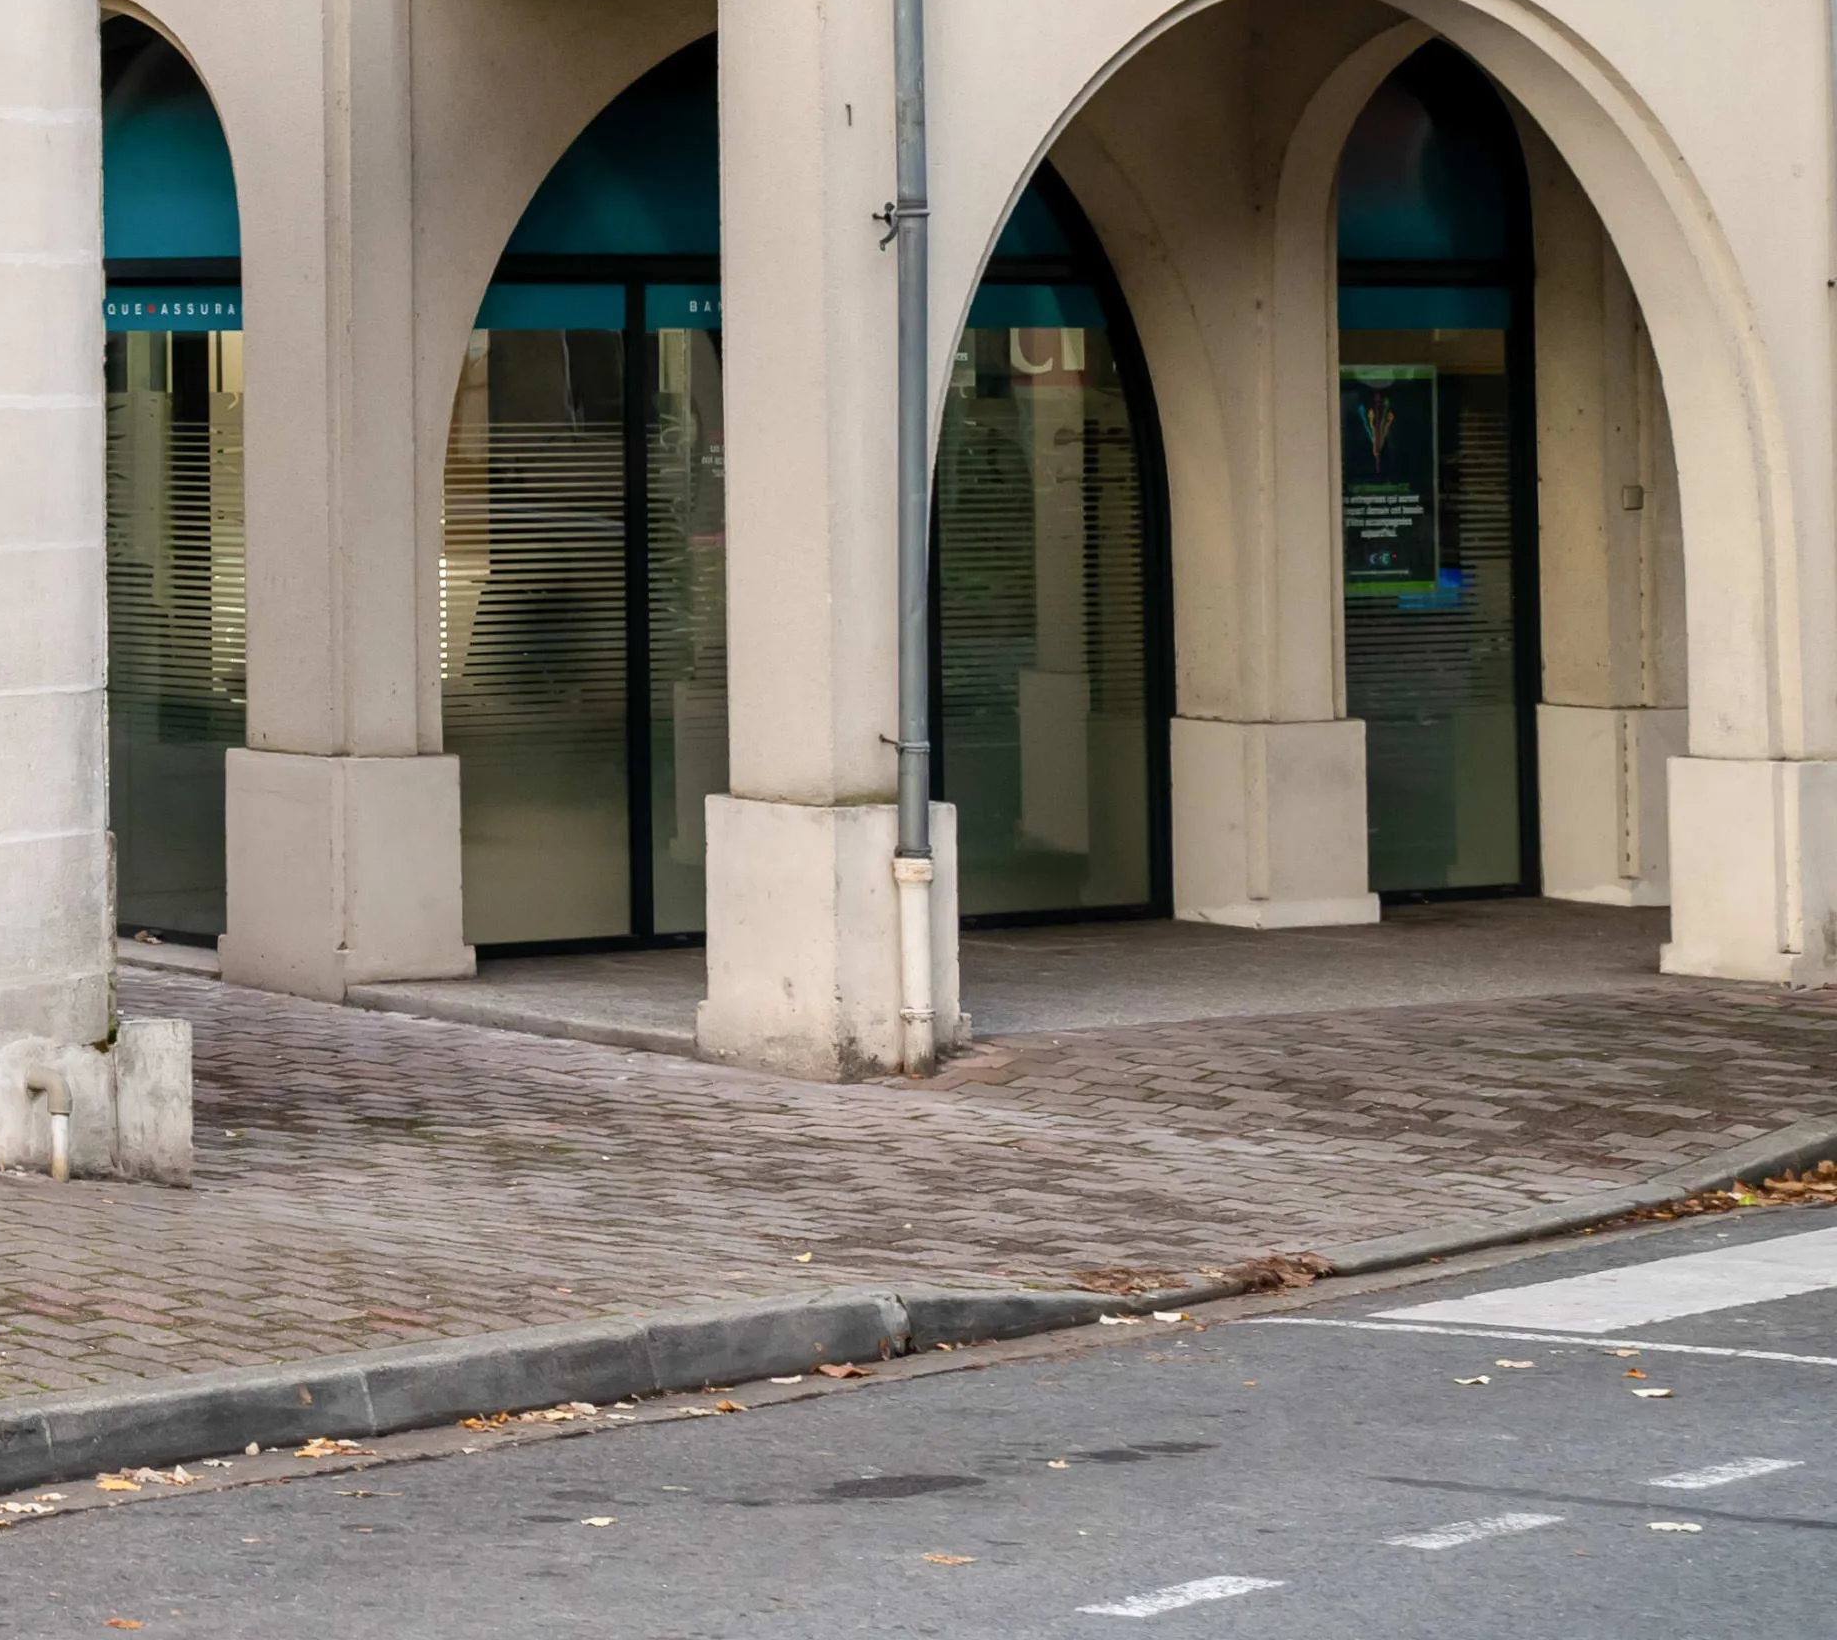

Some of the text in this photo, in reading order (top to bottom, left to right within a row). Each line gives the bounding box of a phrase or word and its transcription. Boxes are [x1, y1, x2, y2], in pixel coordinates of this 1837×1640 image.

[107, 303, 236, 315] QUE ASSURA
[689, 300, 722, 313] BA
